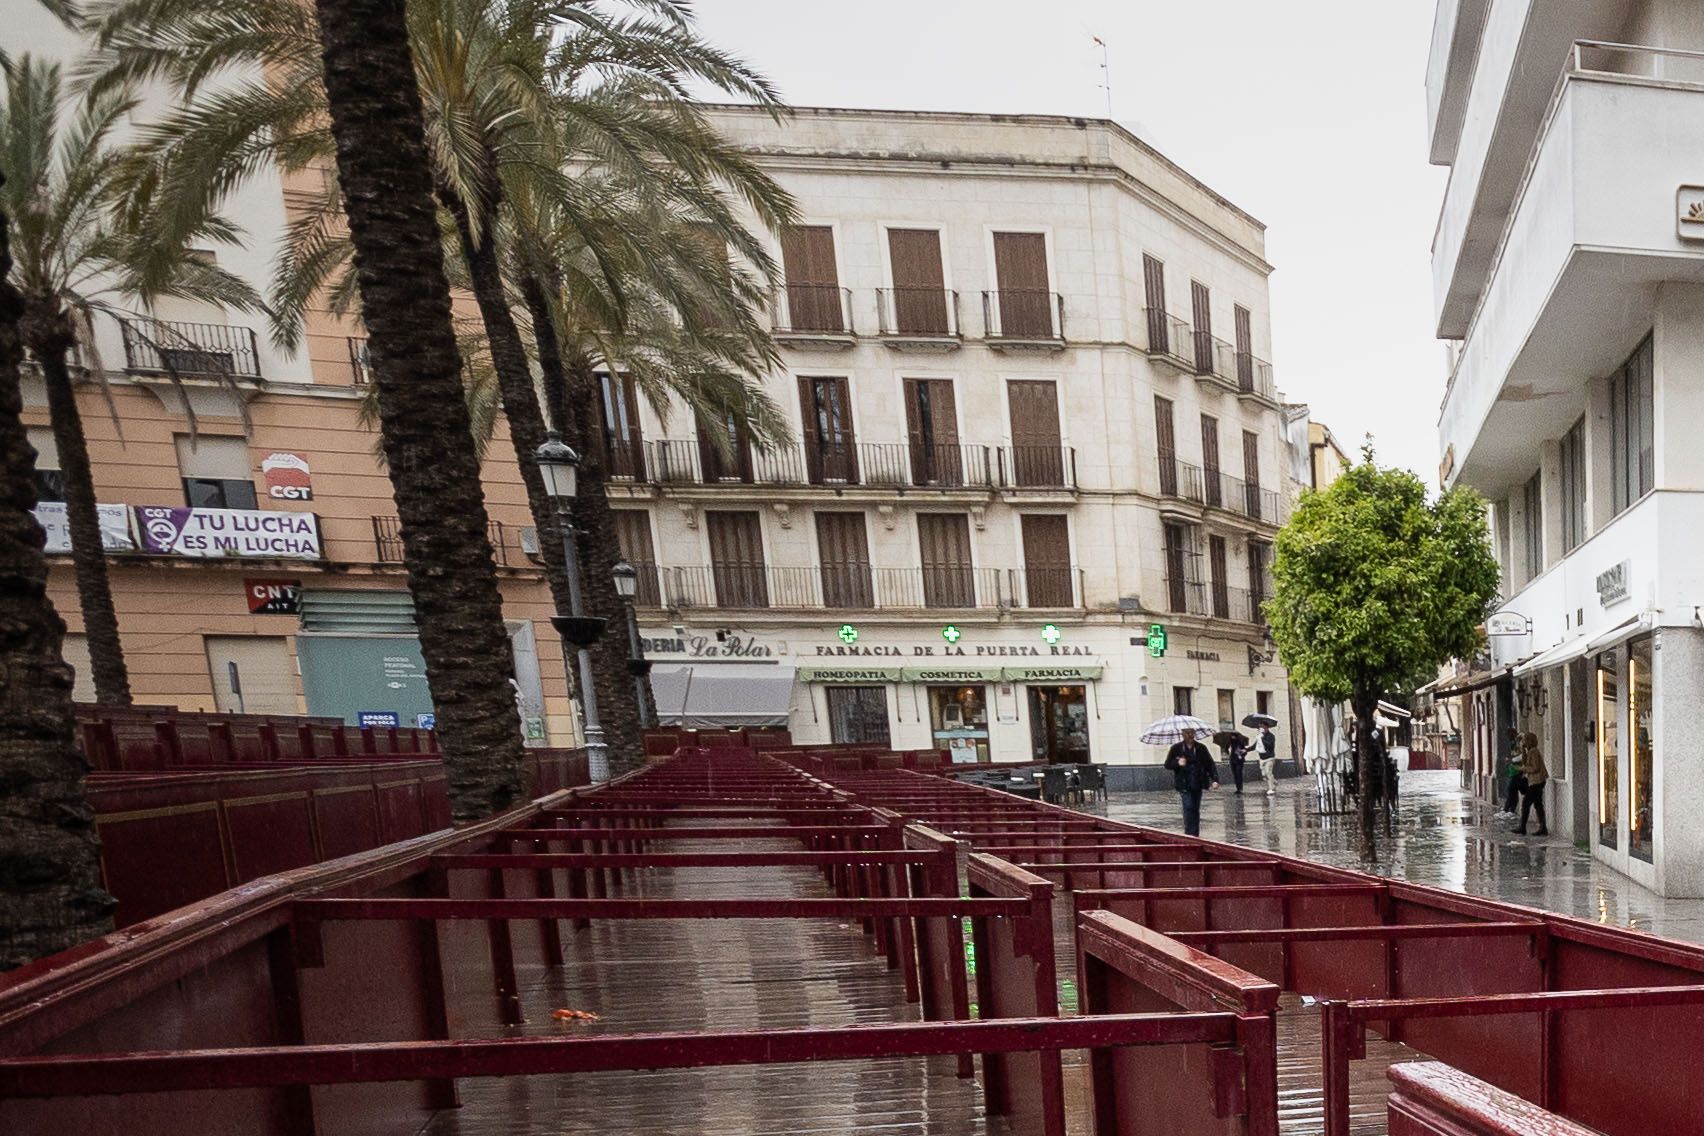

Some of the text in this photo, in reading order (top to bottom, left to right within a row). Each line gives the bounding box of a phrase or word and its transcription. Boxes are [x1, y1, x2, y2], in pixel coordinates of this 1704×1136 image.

[270, 485, 311, 500] CGT
[144, 507, 173, 519] CGT
[193, 514, 313, 535] TU LUCHA
[182, 535, 317, 555] ES MI LUCHA
[253, 584, 296, 600] CNT
[266, 602, 289, 611] AIT
[641, 636, 772, 657] DERIA La Polar
[816, 645, 1093, 657] FARMACIA DE LA PUERTA REAL
[1187, 650, 1220, 662] FARMACIA
[813, 670, 887, 680] HOMEOPATIA
[919, 671, 983, 680] COSMETICA
[1025, 668, 1081, 678] FARMACIA
